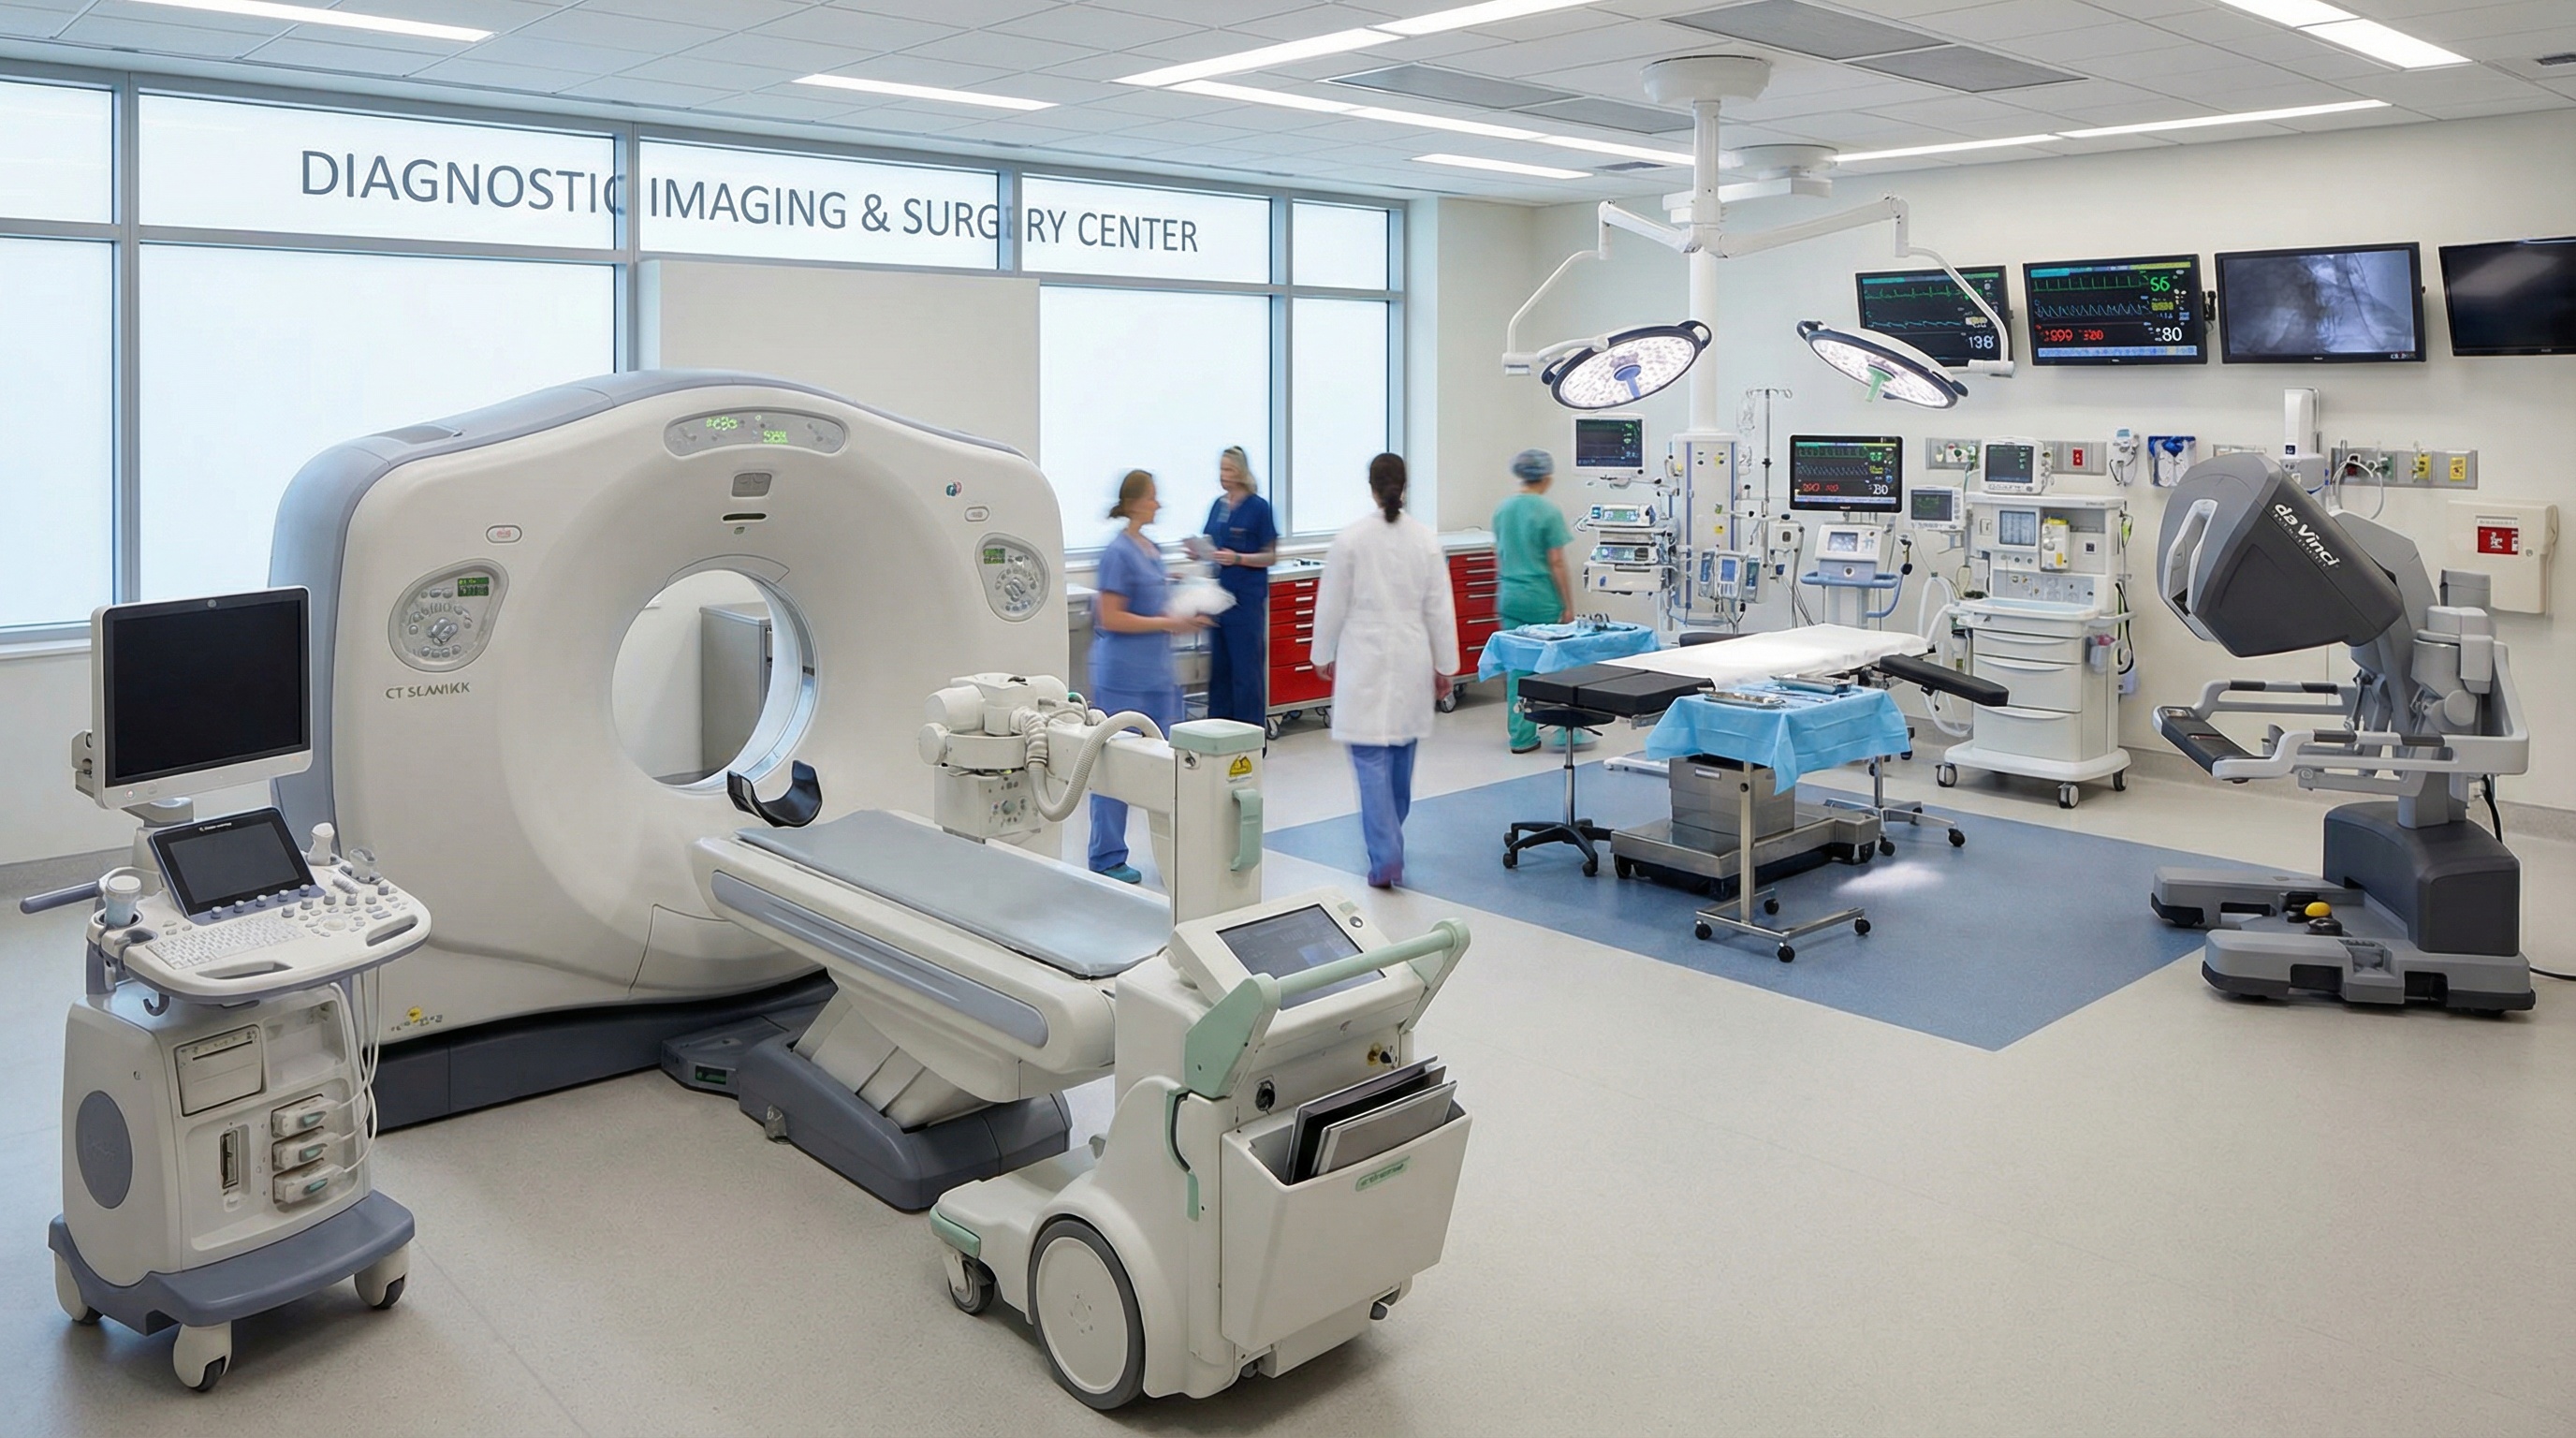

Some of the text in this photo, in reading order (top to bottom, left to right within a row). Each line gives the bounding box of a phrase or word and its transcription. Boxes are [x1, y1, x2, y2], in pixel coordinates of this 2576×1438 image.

[301, 150, 626, 216] DIAGNOSTIC
[651, 177, 846, 229] IMAGING
[861, 193, 891, 232] &
[1077, 212, 1198, 253] CENTER
[1969, 335, 1995, 349] 138
[2161, 327, 2183, 342] 80
[2275, 504, 2299, 525] da
[385, 686, 404, 699] CT
